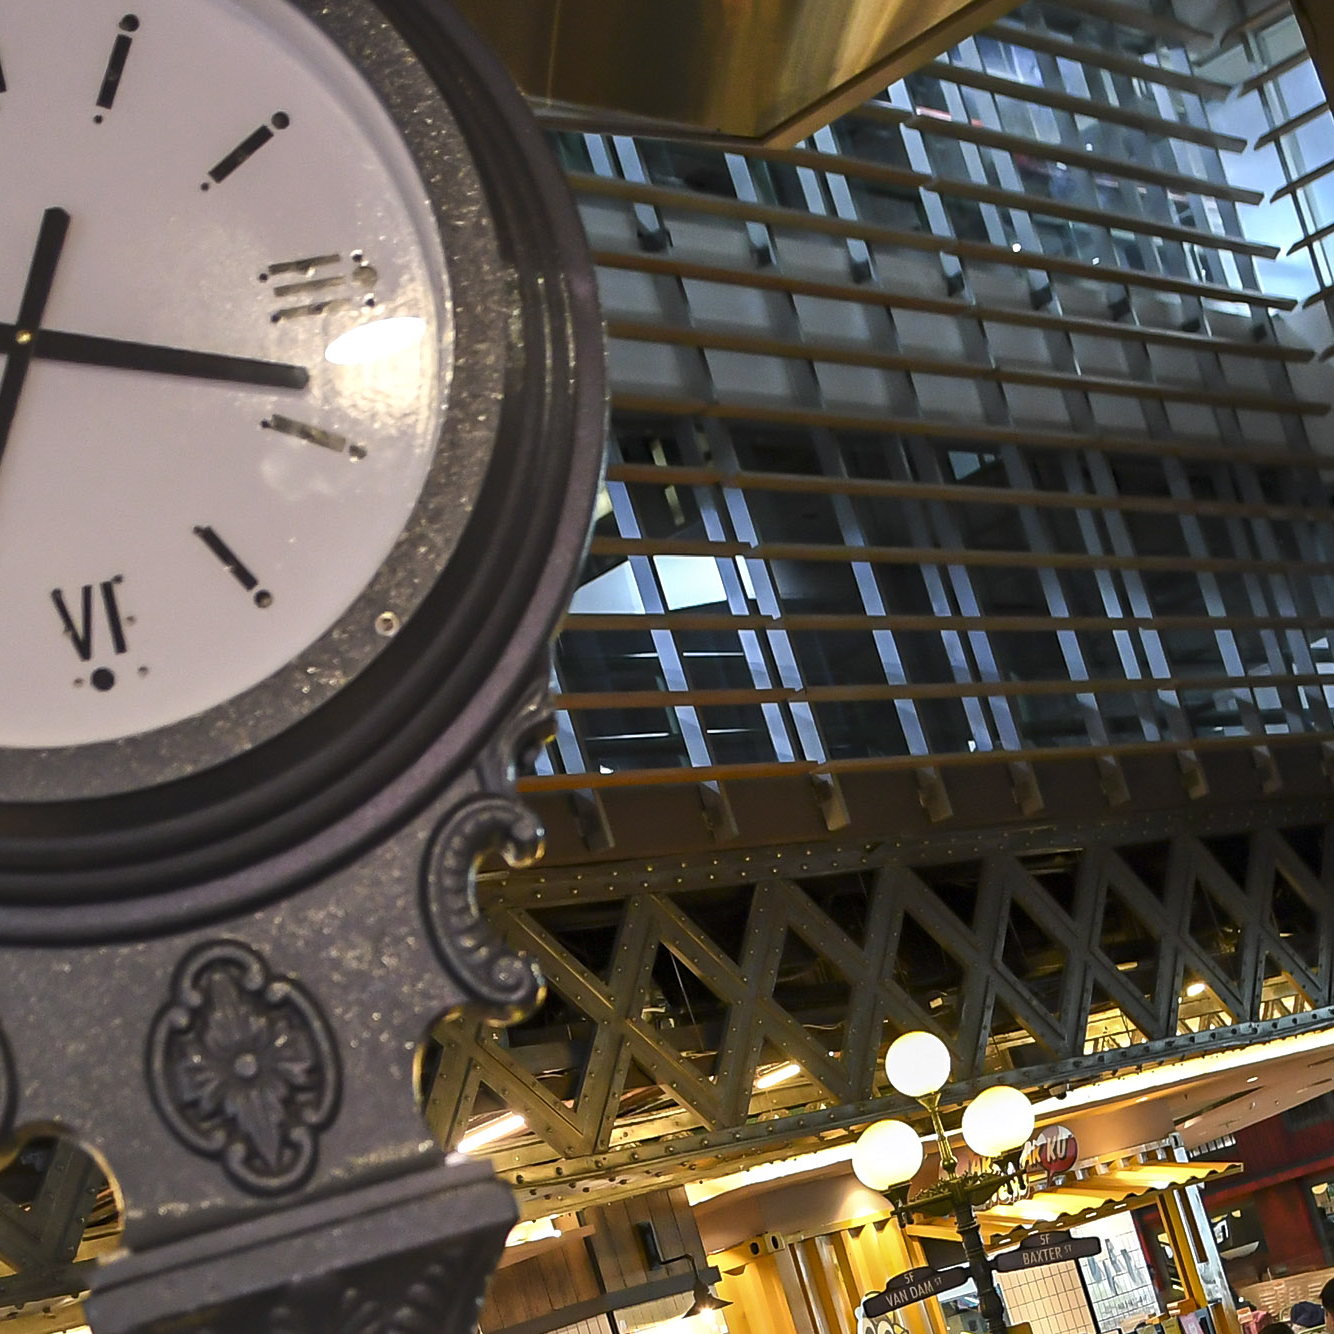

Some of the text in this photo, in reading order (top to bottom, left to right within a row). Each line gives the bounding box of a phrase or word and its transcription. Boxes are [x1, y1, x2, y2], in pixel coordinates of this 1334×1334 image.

[1022, 1246, 1063, 1265] BAXTER
[885, 1289, 909, 1307] VAN
[910, 1279, 934, 1299] DAM
